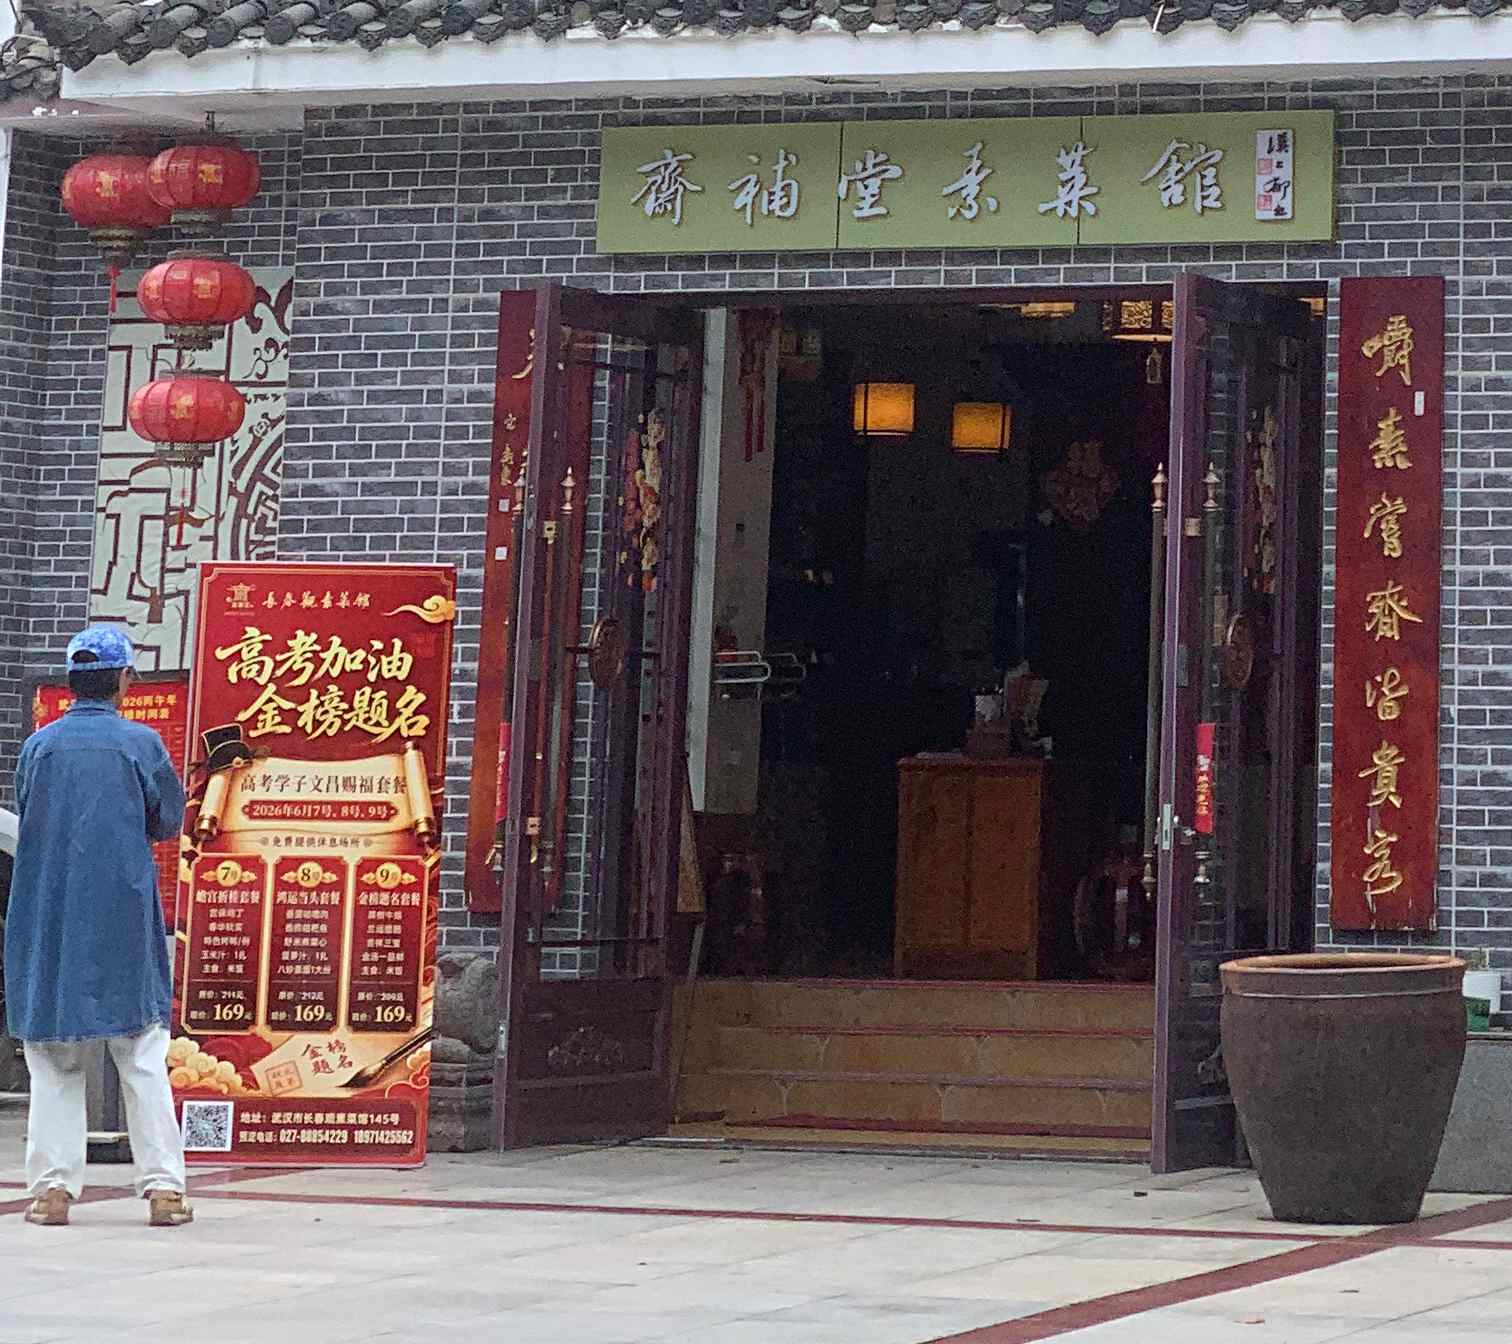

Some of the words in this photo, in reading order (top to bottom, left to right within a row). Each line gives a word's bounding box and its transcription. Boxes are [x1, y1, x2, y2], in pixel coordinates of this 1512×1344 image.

[215, 626, 413, 688] 高考加油
[235, 683, 430, 743] 金榜题名
[240, 774, 408, 794] 高考学子文昌赐福套餐
